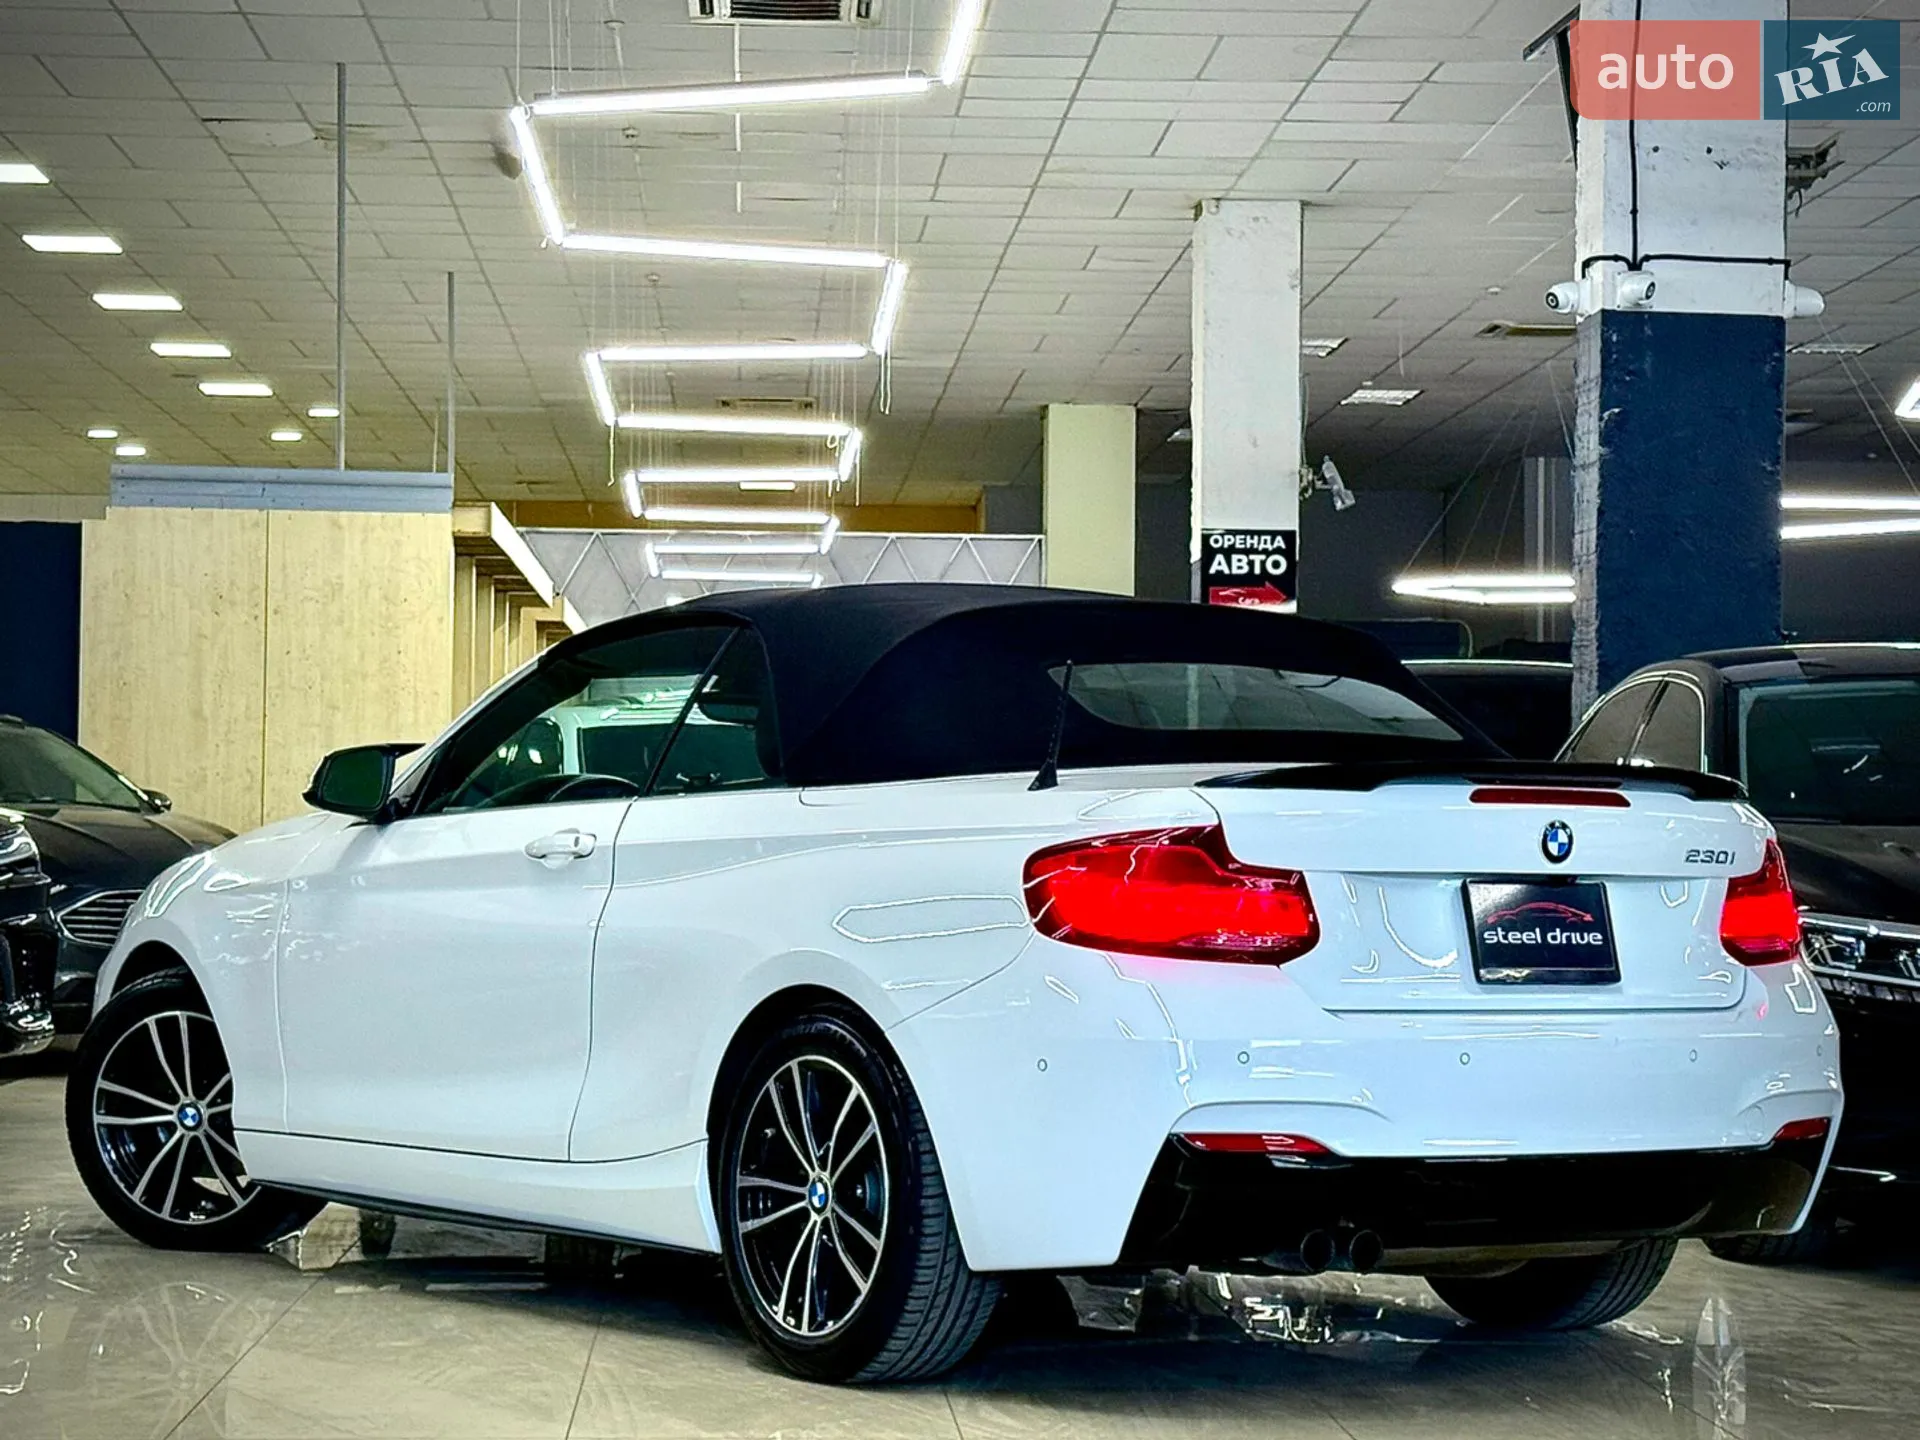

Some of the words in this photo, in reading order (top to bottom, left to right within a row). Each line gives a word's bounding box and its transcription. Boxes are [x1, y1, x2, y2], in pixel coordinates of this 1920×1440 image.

[1209, 534, 1287, 551] ОРЕНДА
[1208, 553, 1288, 576] АВТО
[1483, 927, 1542, 945] steel
[1546, 928, 1604, 946] drive
